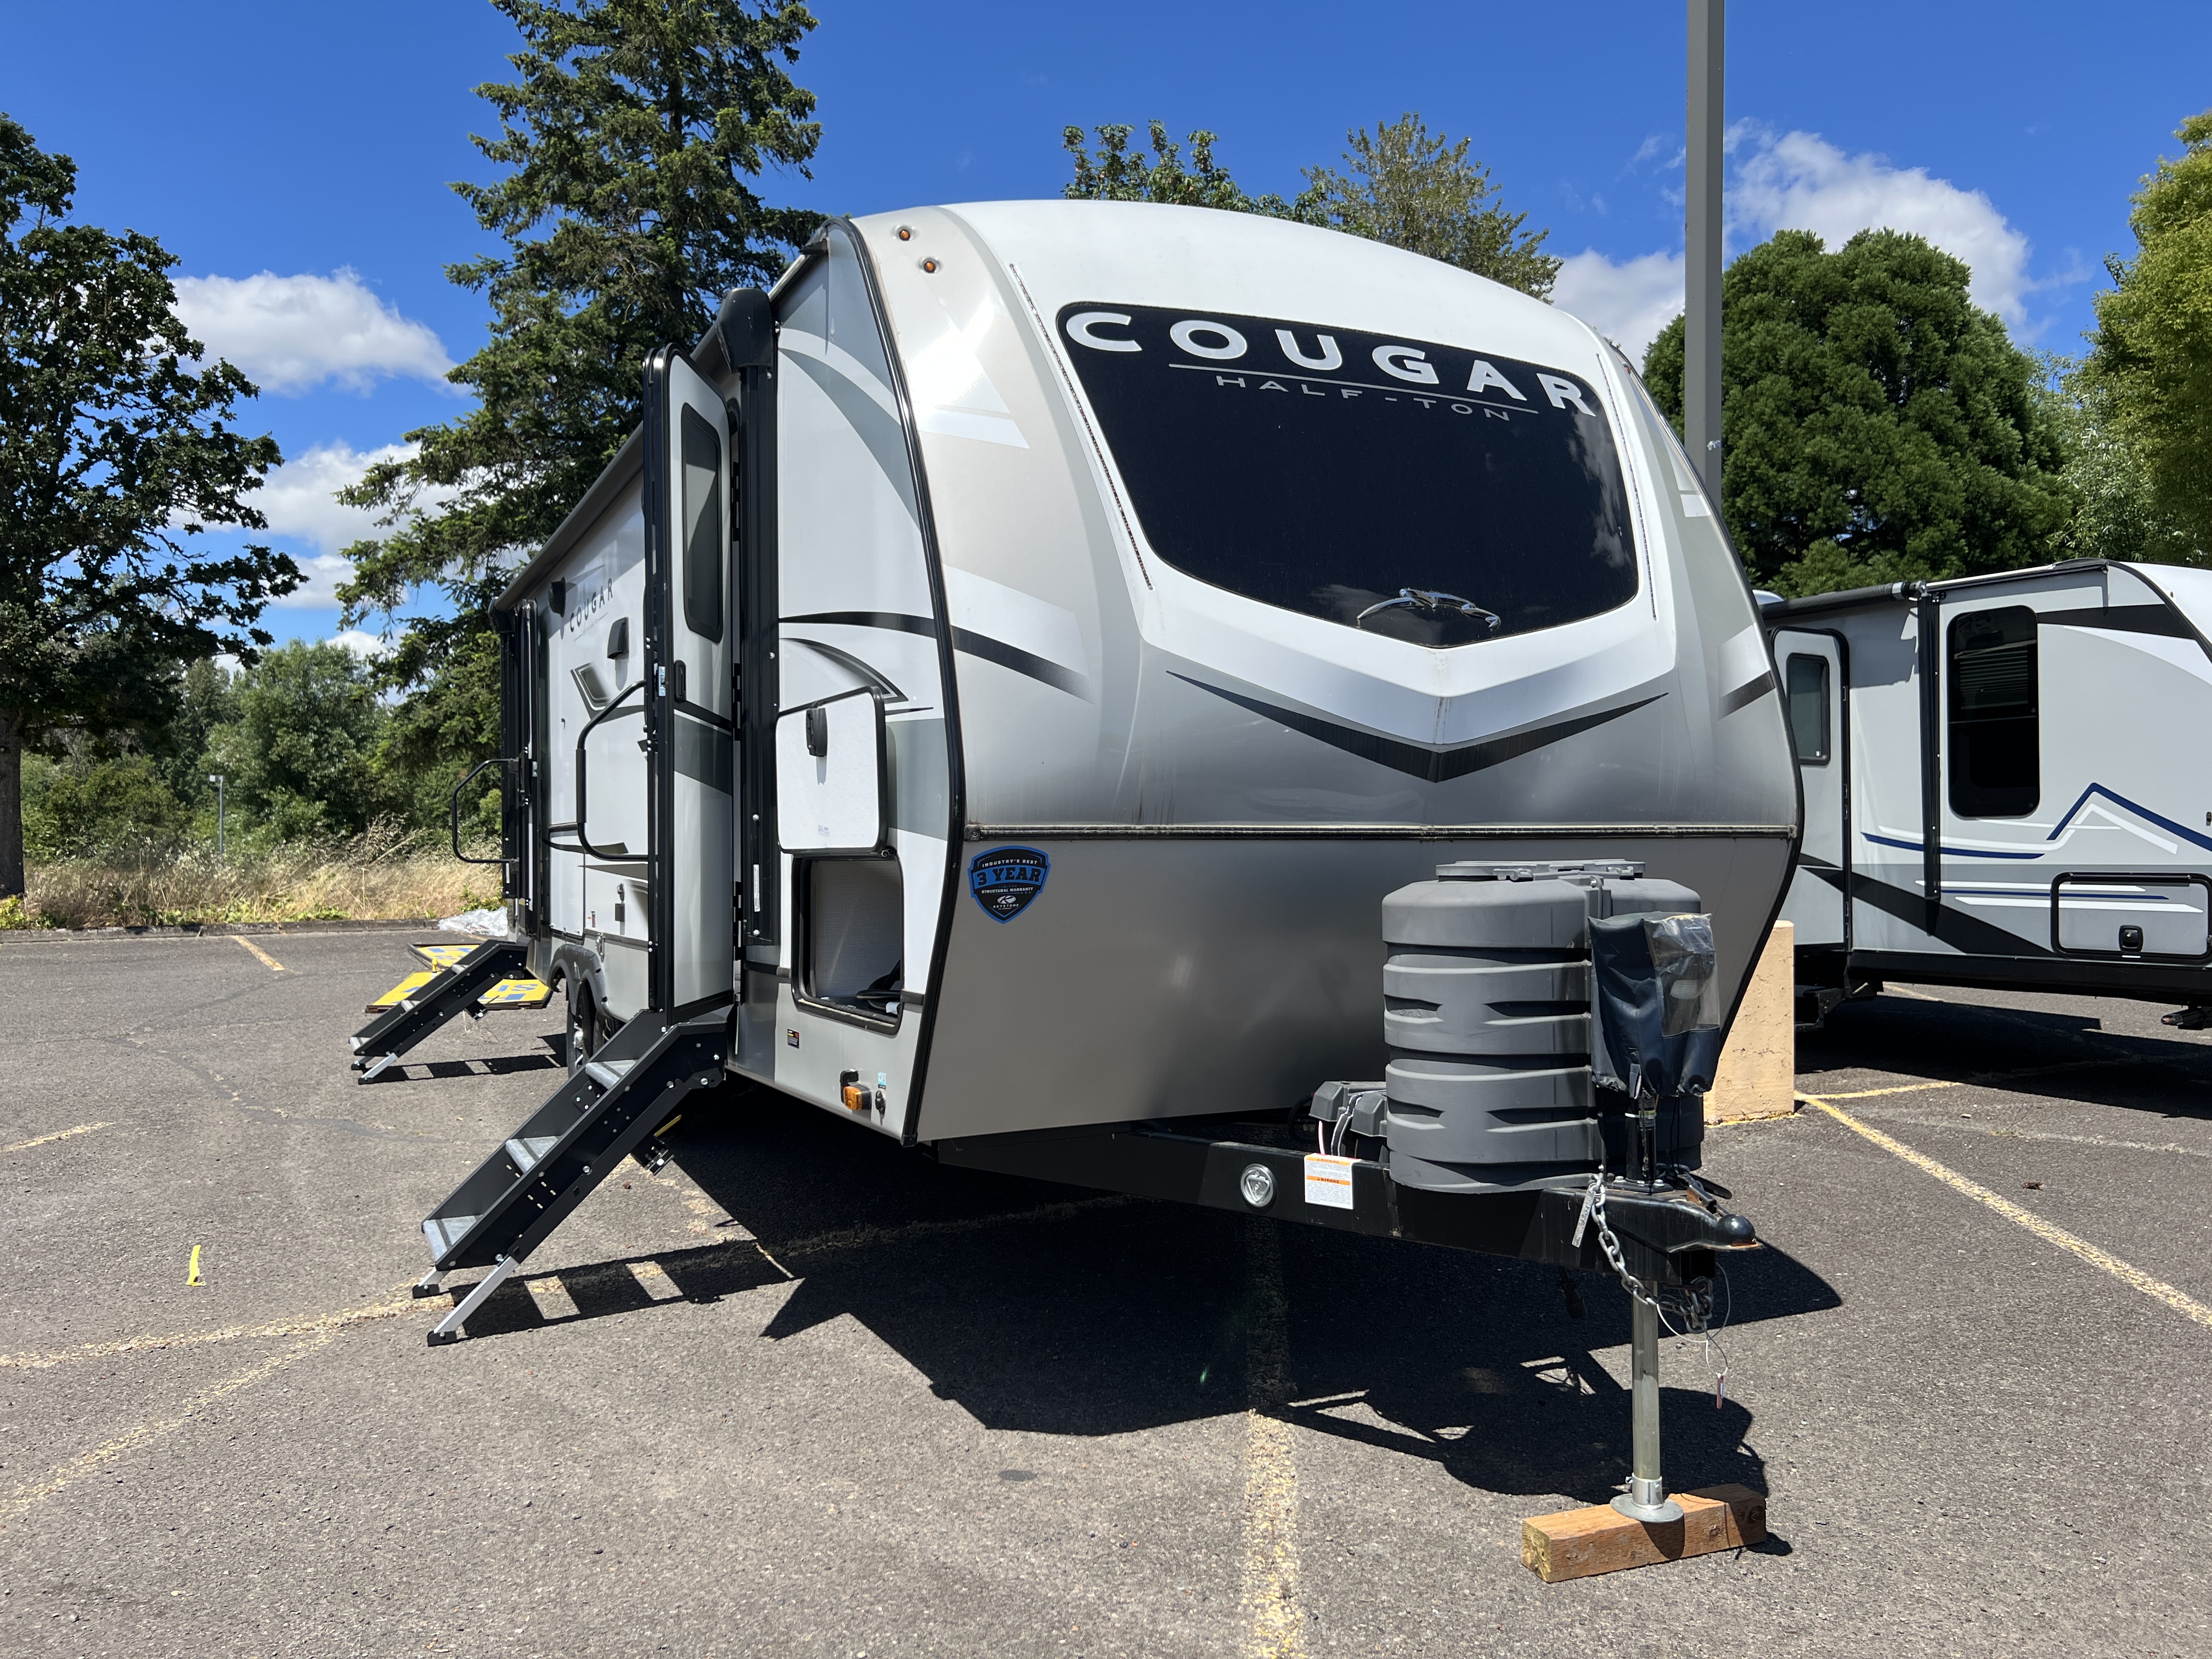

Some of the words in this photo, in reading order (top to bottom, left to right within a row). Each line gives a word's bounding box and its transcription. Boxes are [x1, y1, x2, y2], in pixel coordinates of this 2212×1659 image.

[1065, 311, 1596, 417] COUGAR
[1216, 375, 1510, 421] HALF-TON
[571, 578, 613, 632] COUGAR
[977, 872, 987, 885] 3
[992, 867, 1041, 882] YEAR
[982, 859, 1020, 868] INDUSTRY'S
